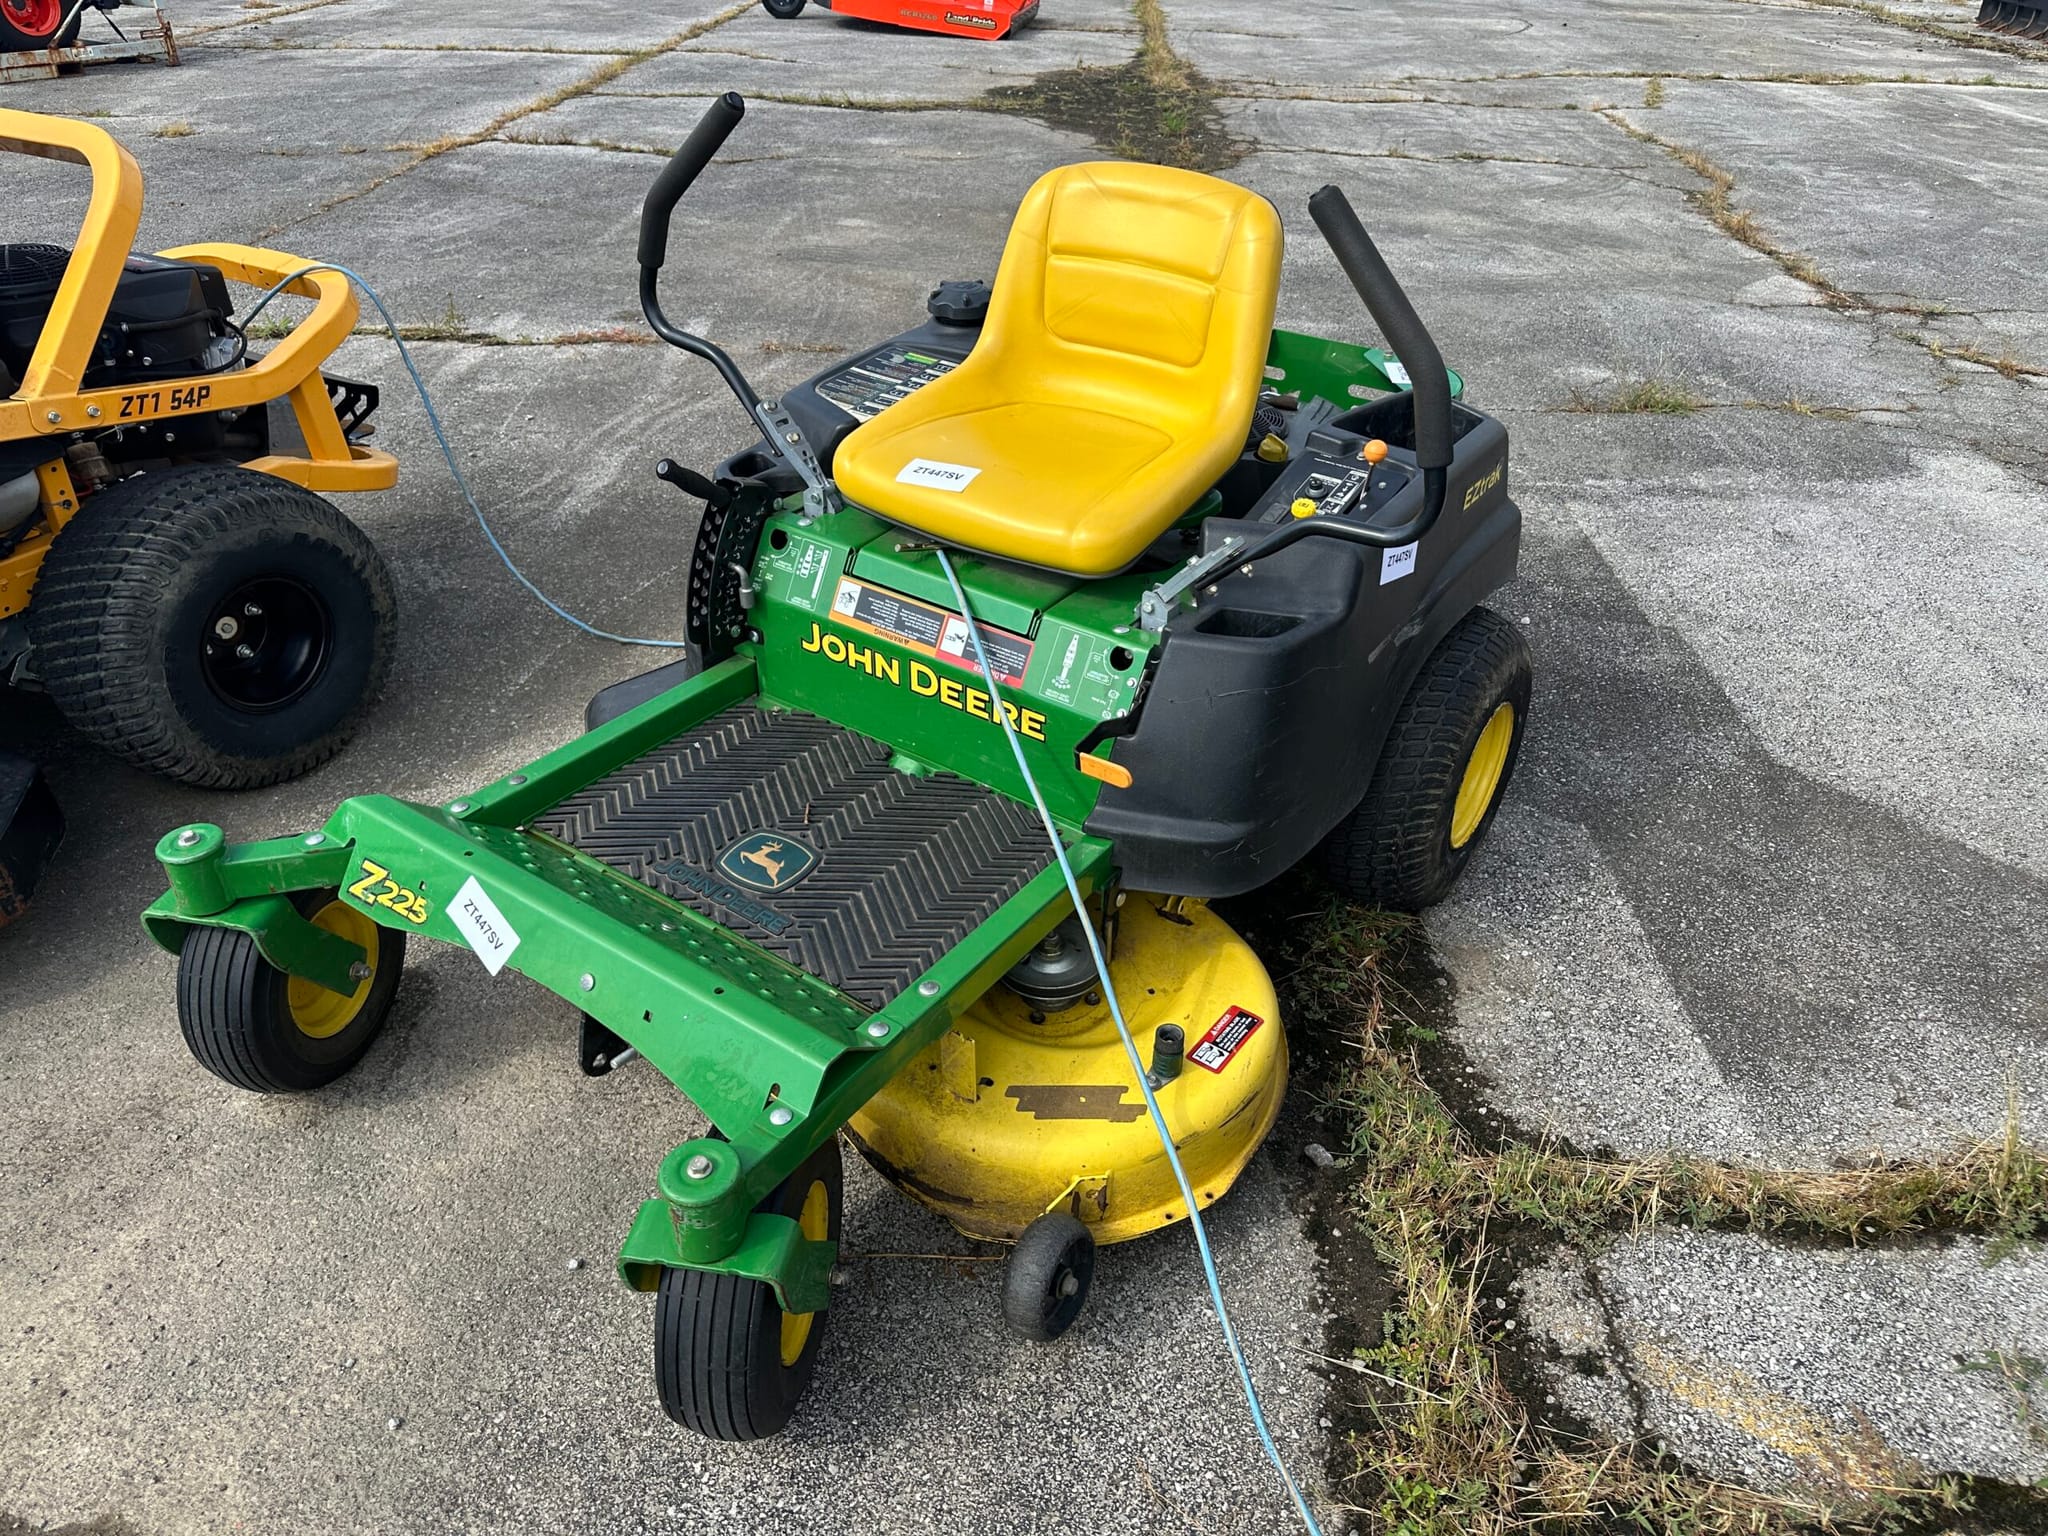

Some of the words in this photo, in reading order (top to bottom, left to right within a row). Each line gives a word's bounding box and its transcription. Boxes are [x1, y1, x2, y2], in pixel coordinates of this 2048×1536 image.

[946, 12, 969, 22] Land
[972, 15, 995, 27] Pride
[120, 392, 160, 418] ZT1
[170, 385, 210, 411] 54P
[913, 466, 965, 480] ZT447SV
[1463, 463, 1503, 512] EZtrak
[1387, 549, 1413, 568] ZT447SV
[801, 621, 900, 686] JOHN
[909, 659, 1047, 743] DEERE
[347, 858, 428, 925] Z225
[655, 858, 714, 898] JOHN
[713, 885, 791, 935] DEERE
[463, 898, 504, 950] ZT447SV
